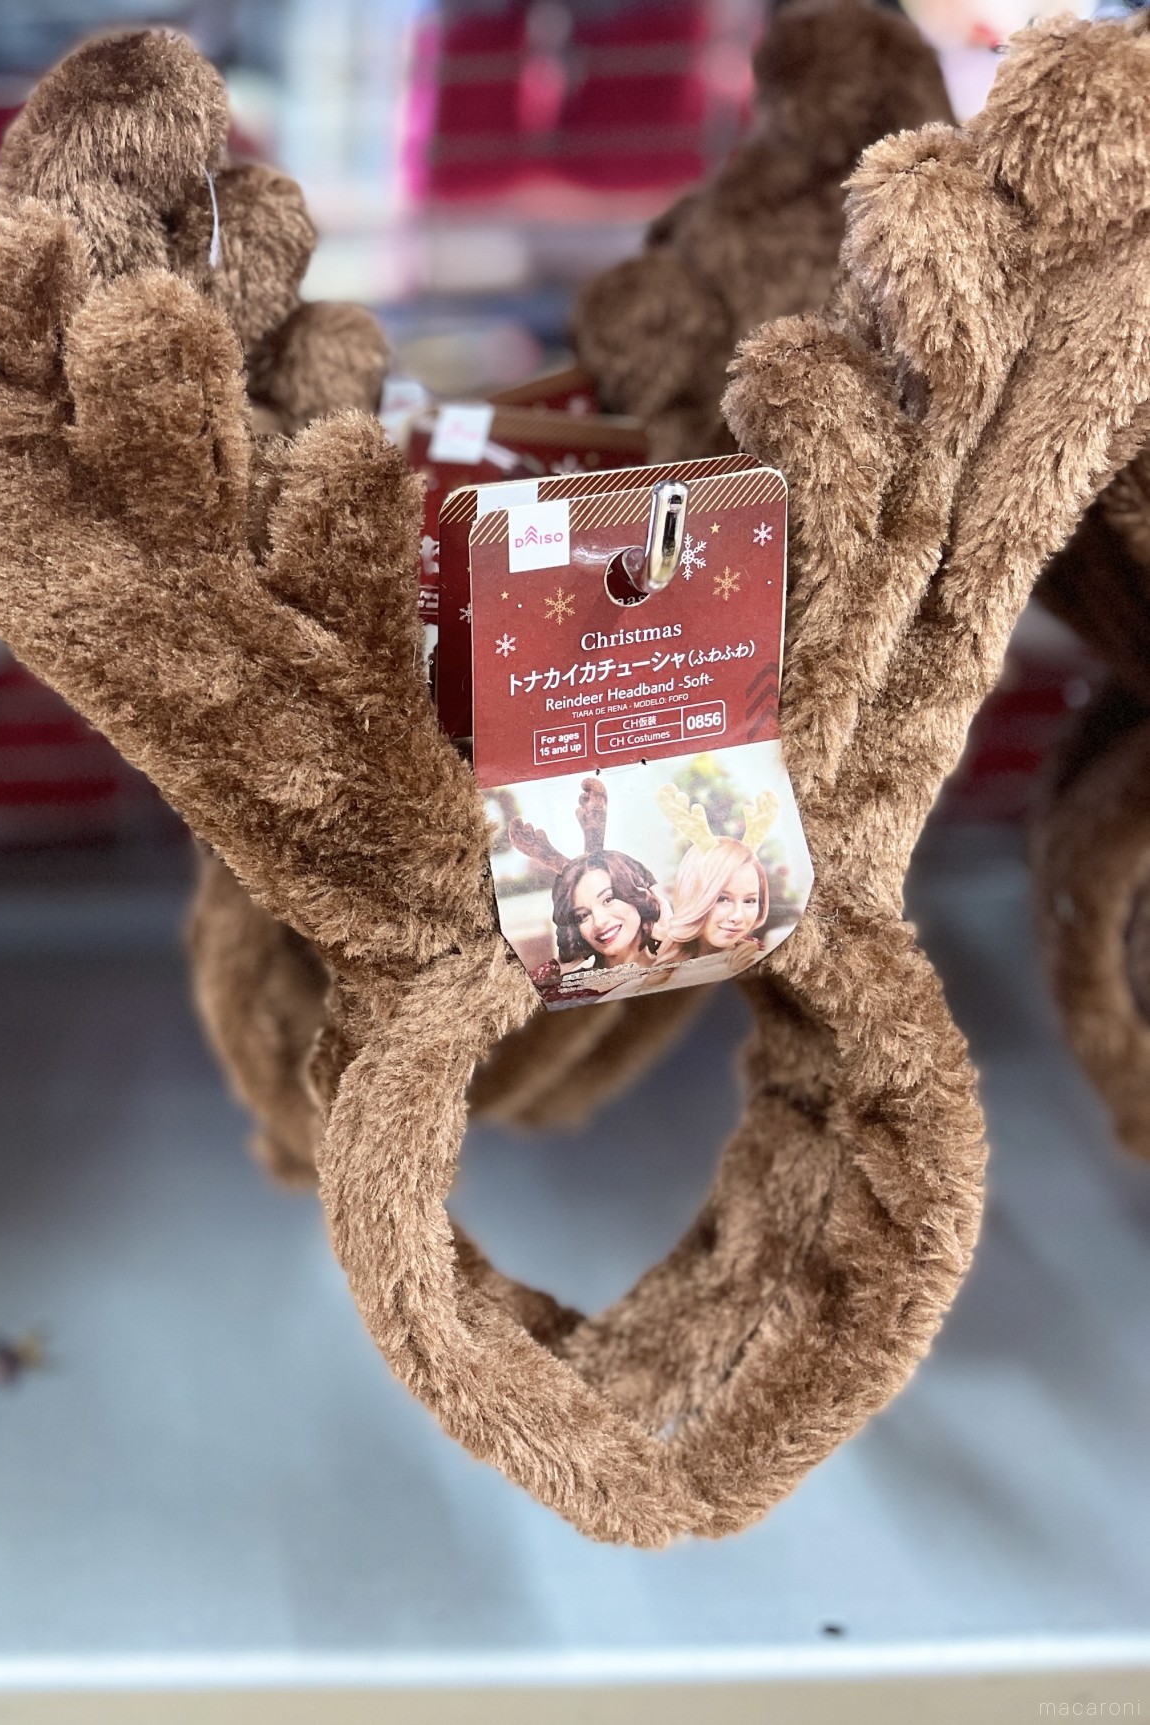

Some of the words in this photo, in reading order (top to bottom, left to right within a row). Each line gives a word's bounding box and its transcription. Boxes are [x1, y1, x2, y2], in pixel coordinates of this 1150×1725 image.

[514, 525, 564, 548] DAISO
[580, 623, 682, 651] Christmas
[509, 639, 755, 697] トナカイカチューシャ(ふわふわ)
[545, 692, 604, 711] Reindeer
[607, 677, 675, 702] Headband
[678, 672, 715, 689] -Soft-
[571, 710, 594, 719] TIARA
[595, 707, 606, 715] DE
[607, 703, 628, 713] RENA
[668, 693, 689, 703] FOFO
[686, 711, 722, 731] 0856
[539, 746, 550, 757] 15
[551, 744, 568, 755] and
[569, 743, 582, 754] up
[540, 735, 555, 745] For
[557, 732, 580, 743] ages
[609, 737, 625, 748] CH
[626, 731, 671, 745] Costumes
